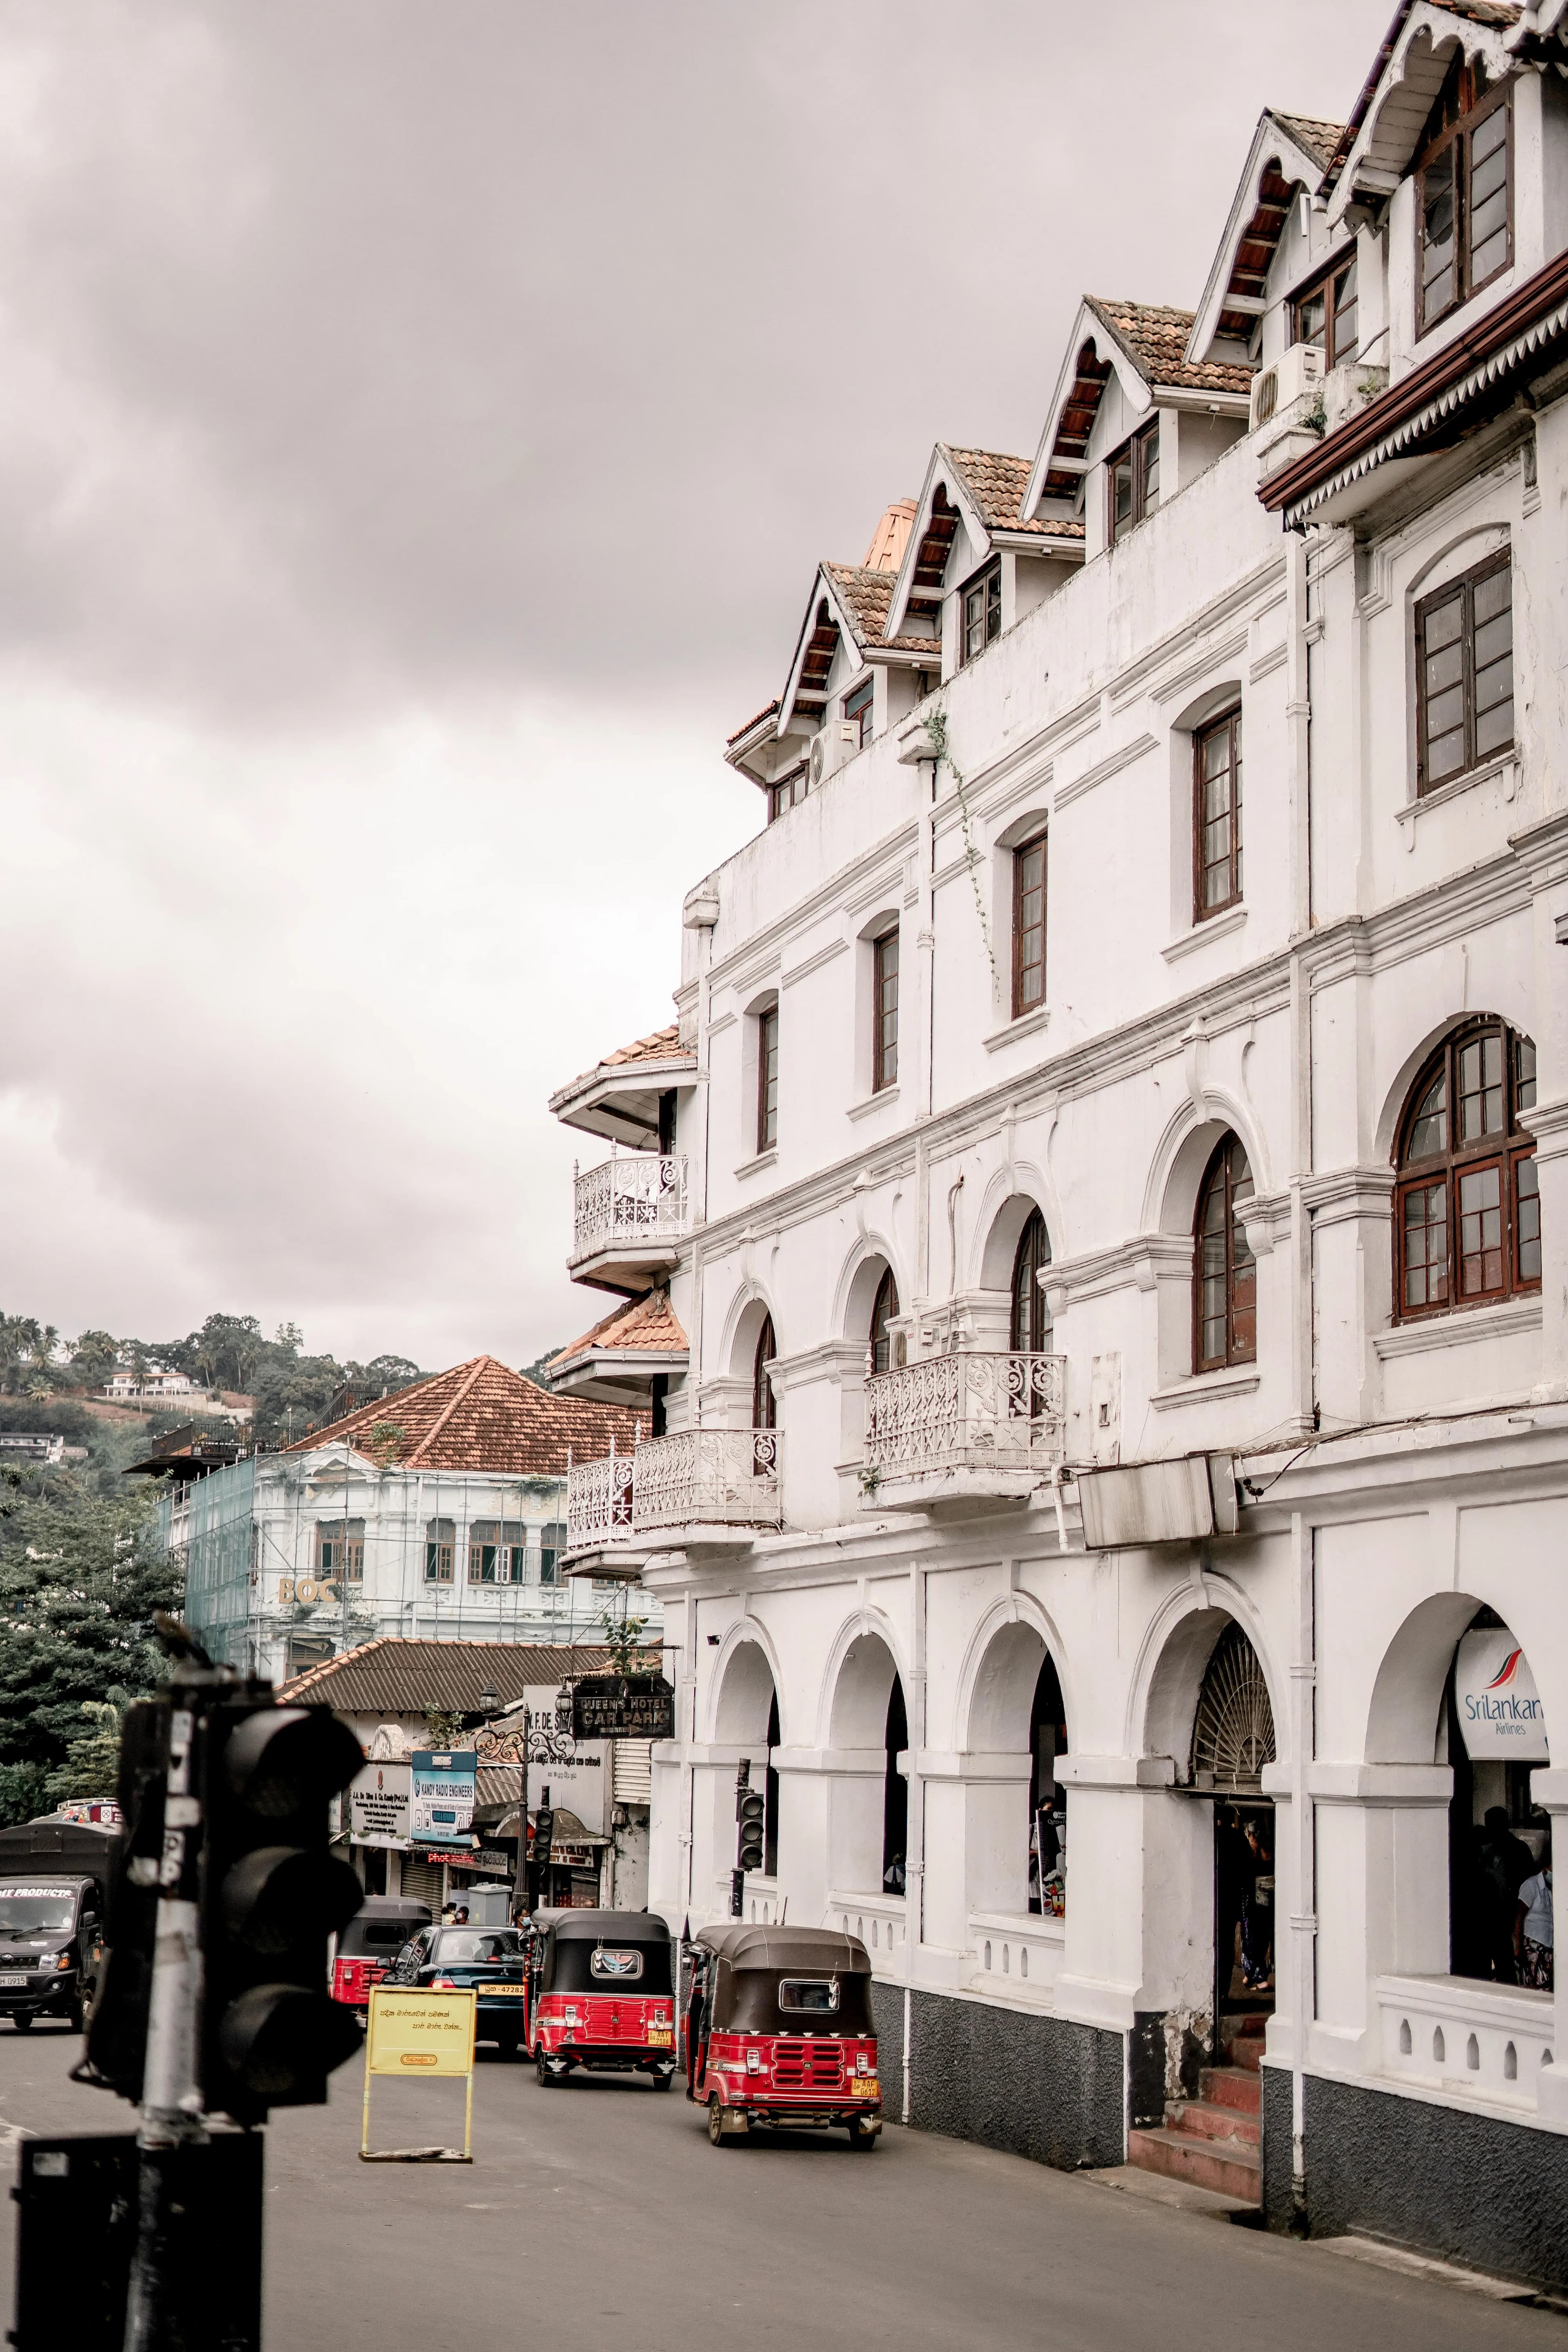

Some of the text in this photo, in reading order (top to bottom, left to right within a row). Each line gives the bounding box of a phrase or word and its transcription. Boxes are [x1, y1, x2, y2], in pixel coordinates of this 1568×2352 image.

[279, 1578, 336, 1604] BOC
[631, 1699, 666, 1708] HOTEL
[1466, 1694, 1544, 1720] SriLankan
[583, 1712, 664, 1725] CAR PARK
[1496, 1722, 1526, 1735] Airlines
[421, 1784, 472, 1798] KANDY RADIO ENGINEERS
